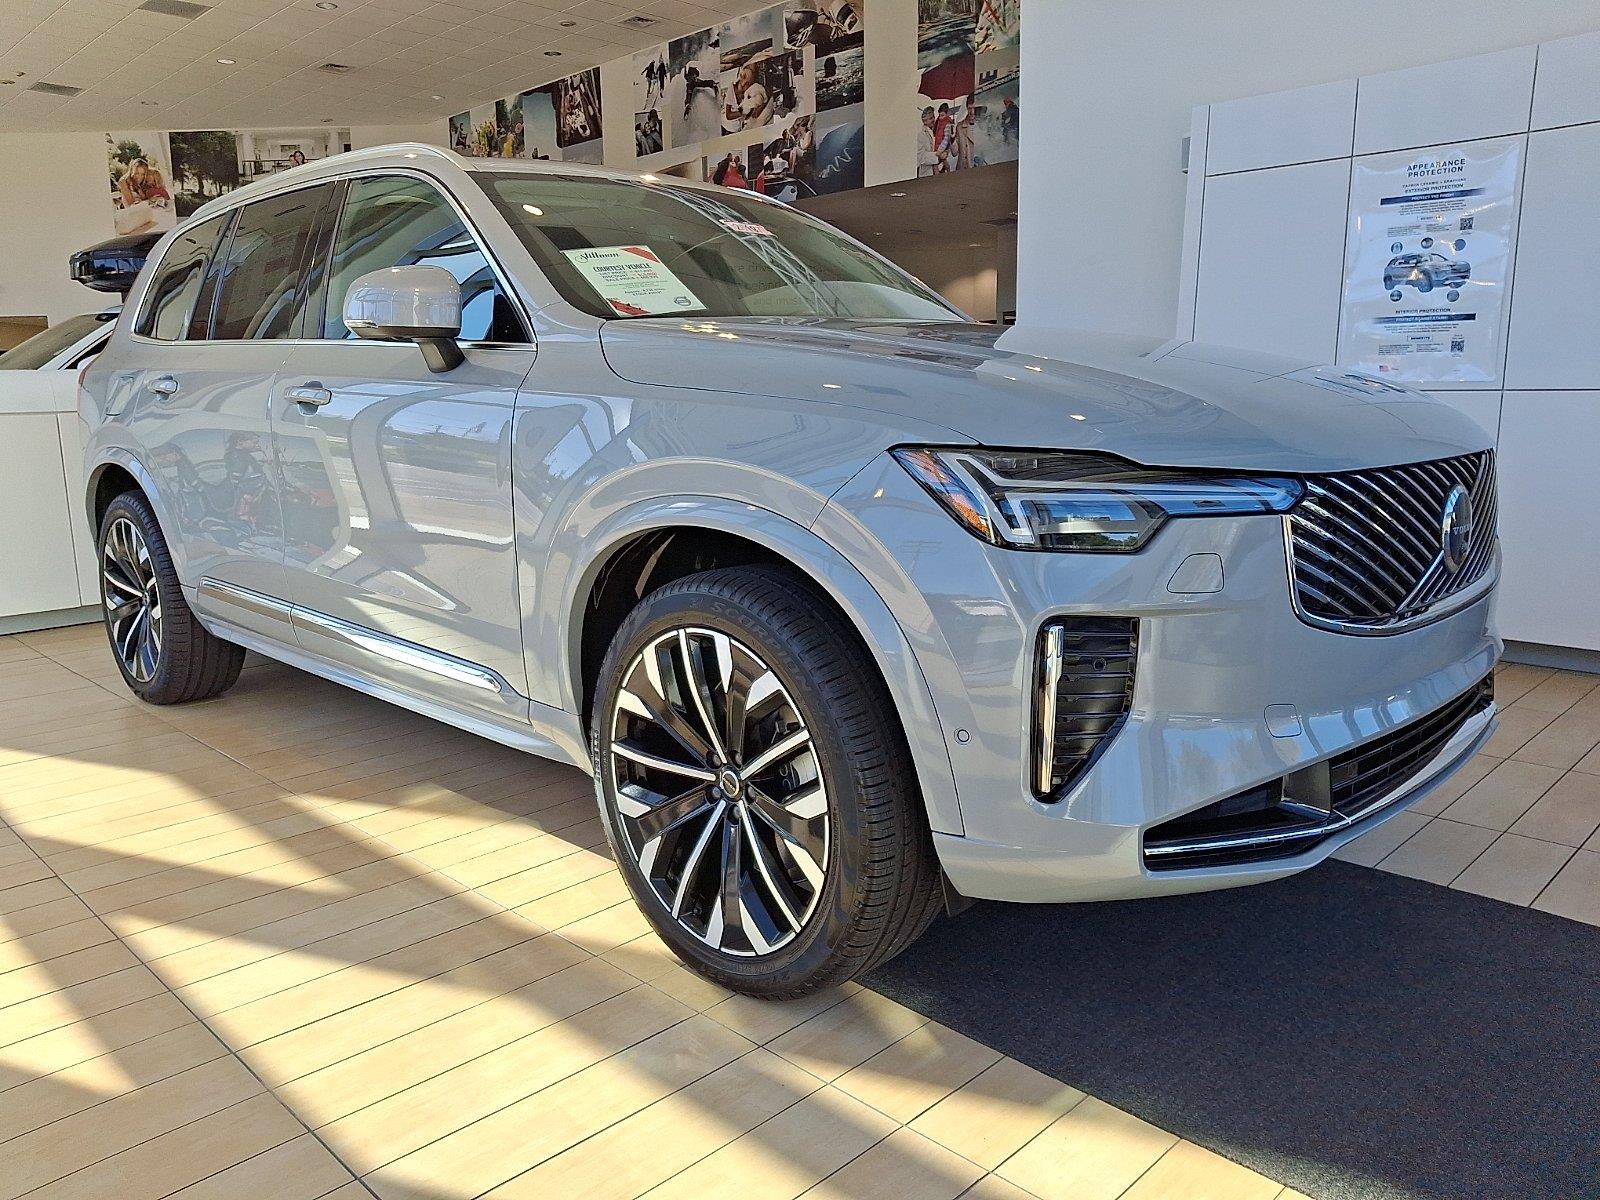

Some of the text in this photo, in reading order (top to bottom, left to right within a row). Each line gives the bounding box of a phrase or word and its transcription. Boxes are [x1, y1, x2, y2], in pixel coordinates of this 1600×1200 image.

[1407, 158, 1466, 172] APPEARANCE
[1408, 166, 1464, 178] PROTECTION
[1405, 183, 1464, 194] EXTERIOR PROTECTION
[575, 251, 620, 264] Stillman
[593, 264, 625, 273] COURTESY
[625, 262, 653, 271] VEHICLE
